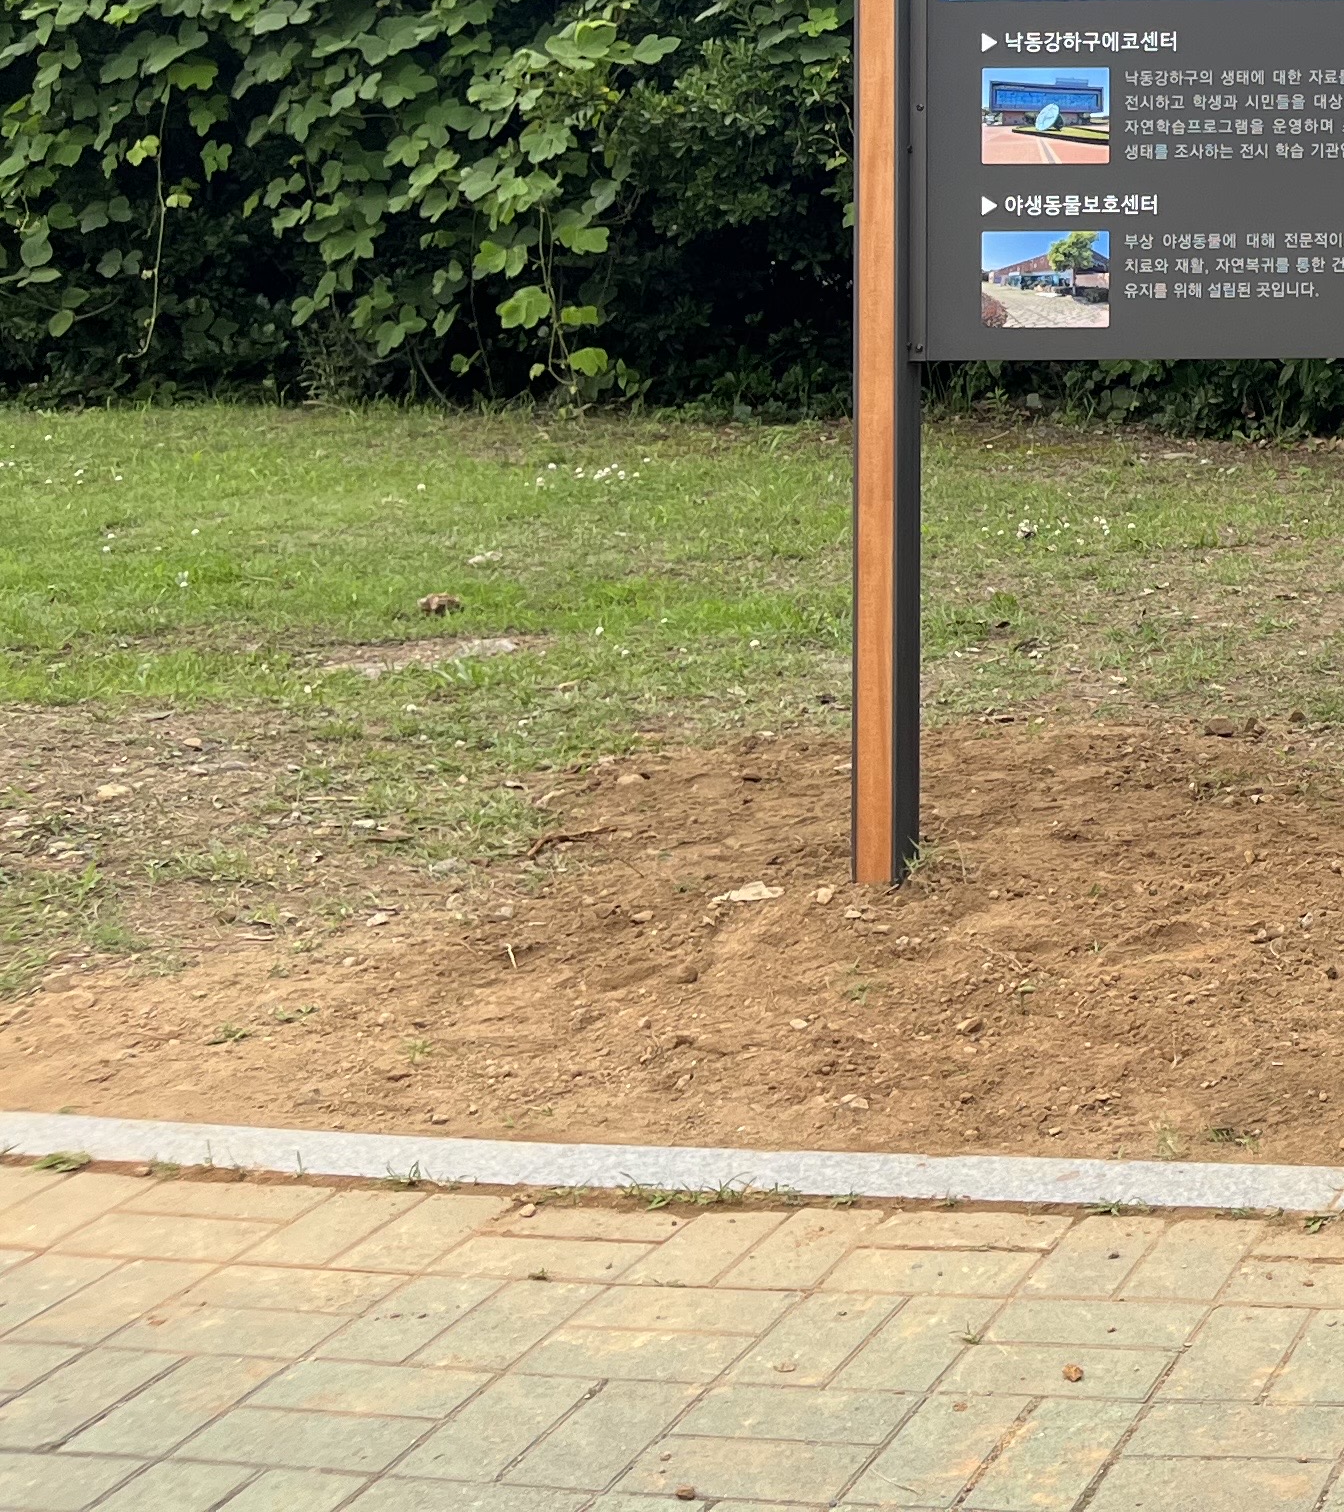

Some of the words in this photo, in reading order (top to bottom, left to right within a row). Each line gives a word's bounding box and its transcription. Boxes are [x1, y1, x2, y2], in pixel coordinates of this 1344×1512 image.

[1005, 31, 1176, 52] 낙동강하구에코센터
[1124, 70, 1212, 86] 낙동강하구의
[1220, 70, 1264, 86] 생태에
[1272, 69, 1302, 85] 대한
[1124, 94, 1184, 110] 전시하고
[1193, 94, 1238, 110] 학생과
[1244, 93, 1305, 110] 시민들을
[1124, 118, 1264, 135] 자연학습프로그램을
[1272, 118, 1332, 134] 운영하며
[1124, 143, 1168, 160] 생태를
[1173, 143, 1233, 159] 조사하는
[1239, 143, 1268, 158] 전시
[1275, 142, 1304, 158] 학습
[1004, 194, 1157, 216] 야생동물보호센터
[1123, 233, 1154, 250] 부상
[1162, 233, 1236, 249] 야생동물에
[1246, 232, 1274, 248] 대해
[1124, 258, 1168, 273] 치료와
[1174, 257, 1208, 274] 재활,
[1215, 257, 1289, 273] 자연복귀를
[1295, 256, 1325, 273] 통한
[1123, 282, 1167, 298] 유지를
[1173, 282, 1201, 298] 위해
[1207, 282, 1250, 298] 설립된
[1256, 281, 1319, 297] 곳입니다.
